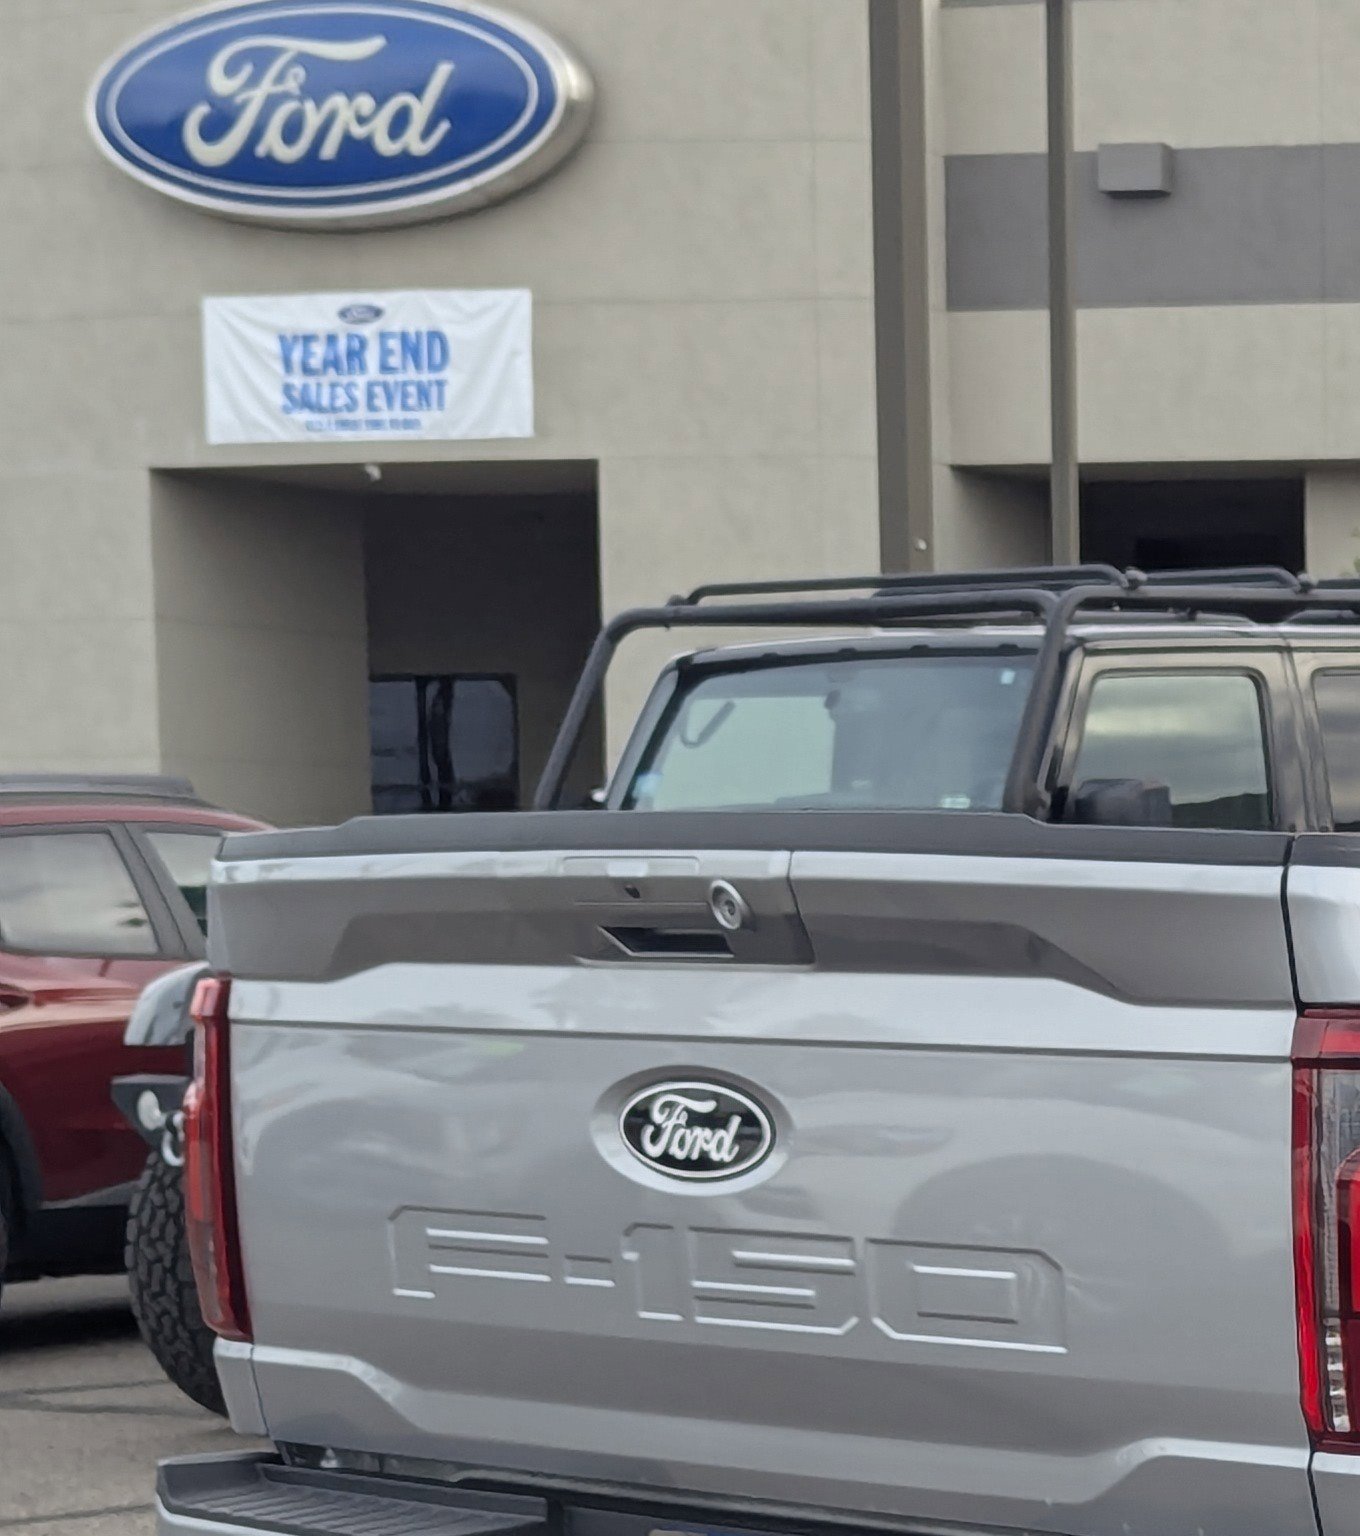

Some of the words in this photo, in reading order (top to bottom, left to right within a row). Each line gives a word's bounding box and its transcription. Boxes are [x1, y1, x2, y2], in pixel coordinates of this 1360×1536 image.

[182, 34, 454, 167] Ford
[278, 331, 367, 377] YEAR
[378, 329, 450, 376] END
[281, 381, 360, 415] SALES
[366, 378, 447, 413] EVENT
[641, 1093, 742, 1163] Ford
[387, 1205, 1069, 1355] F-150
